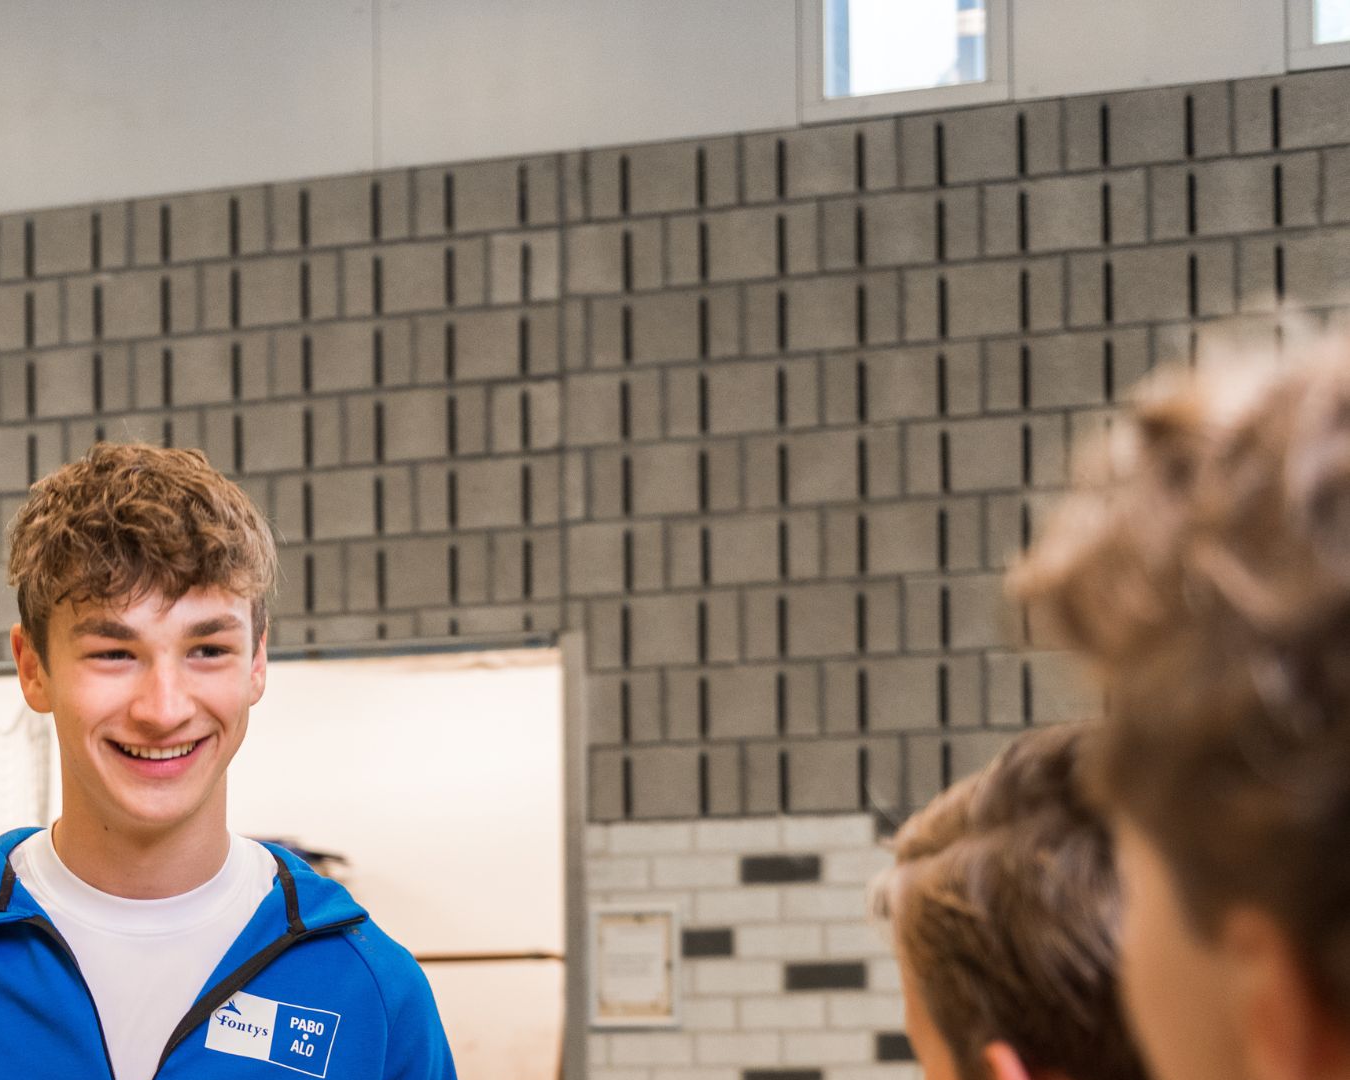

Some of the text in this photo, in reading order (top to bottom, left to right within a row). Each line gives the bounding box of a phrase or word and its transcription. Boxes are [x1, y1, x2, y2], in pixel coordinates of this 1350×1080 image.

[219, 1014, 269, 1037] Fontys
[290, 1016, 325, 1036] PABO
[290, 1039, 315, 1058] ALO
